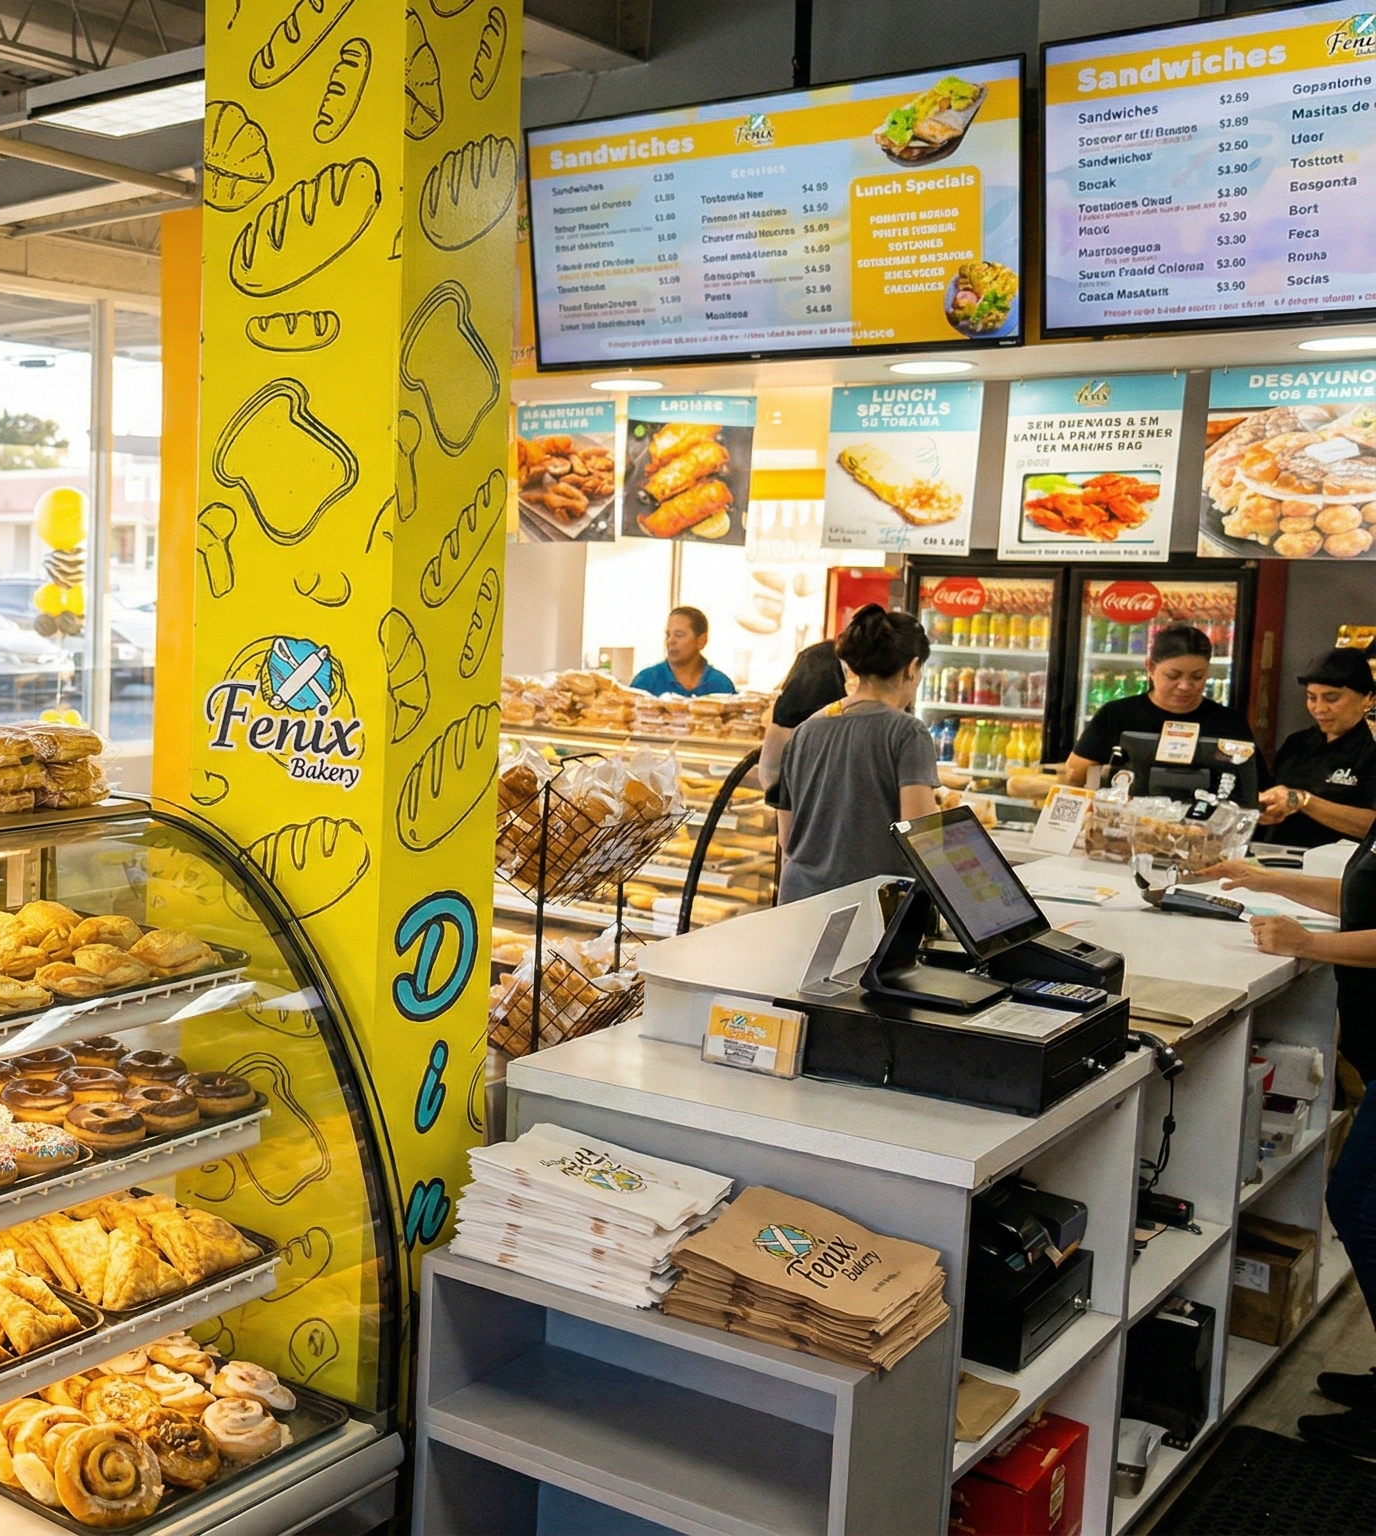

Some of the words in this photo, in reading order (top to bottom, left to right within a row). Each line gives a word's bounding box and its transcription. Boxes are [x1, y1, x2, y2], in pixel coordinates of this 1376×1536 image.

[1077, 45, 1287, 93] Sandwiches
[1078, 104, 1159, 125] Sandwiches
[1292, 104, 1348, 120] Masitas
[1351, 101, 1370, 113] de
[549, 135, 695, 171] Sandwiches
[1217, 139, 1249, 153] $2.50
[855, 180, 902, 198] Lunch
[905, 172, 976, 195] Specials
[1288, 203, 1320, 217] Bort
[1288, 228, 1321, 240] Feca
[1248, 369, 1376, 389] DESAYUNO
[871, 388, 938, 403] LUNCH
[856, 402, 952, 417] SPECIALS
[206, 682, 362, 758] Fenix
[290, 757, 360, 789] Bakery
[785, 1234, 859, 1290] Fenix
